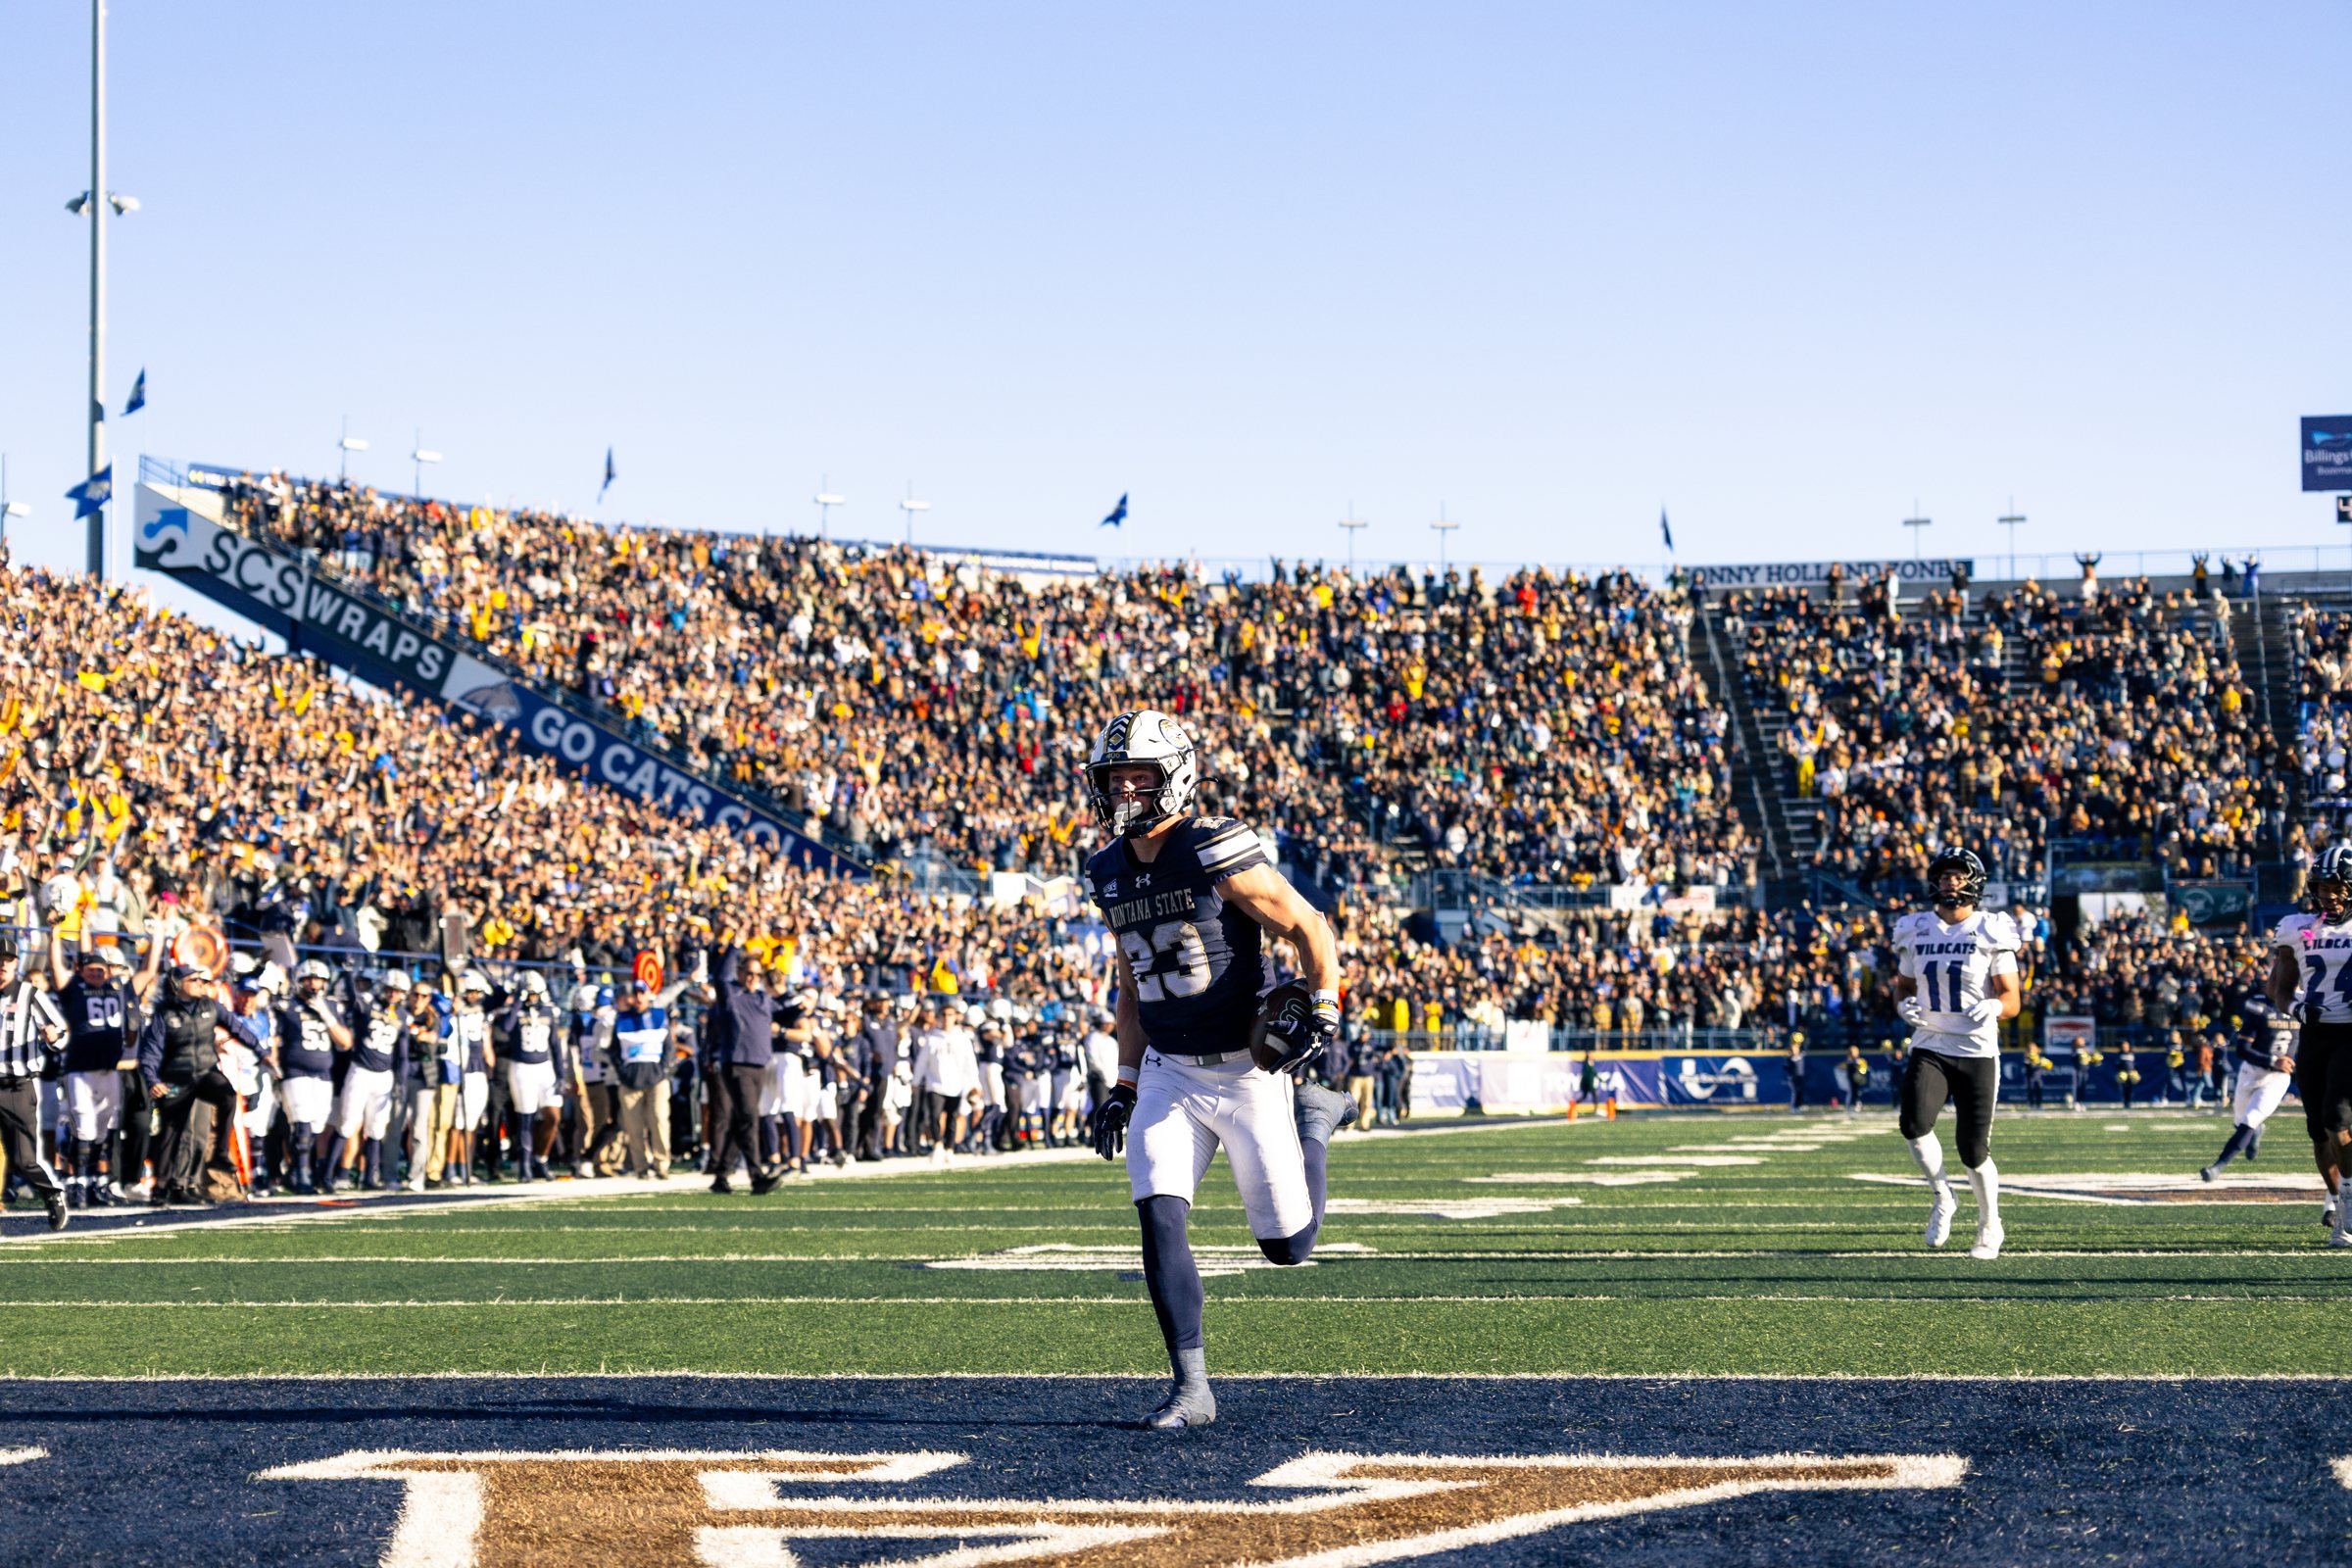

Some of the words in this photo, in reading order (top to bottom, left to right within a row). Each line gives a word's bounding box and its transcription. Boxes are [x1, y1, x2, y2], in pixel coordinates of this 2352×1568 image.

[2305, 450, 2349, 466] Billings
[1684, 565, 1760, 584] ONNY
[1768, 562, 1881, 583] HOLLND
[307, 583, 446, 680] WRAPS
[531, 708, 596, 761] GO
[601, 744, 712, 816] CATS
[1109, 897, 1152, 929] MONTANA
[1155, 887, 1196, 916] STATE
[1120, 920, 1212, 1003] 23
[1915, 943, 1977, 956] WILDCATS
[1923, 960, 1964, 1012] 11
[86, 997, 122, 1028] 60
[301, 1019, 331, 1052] 53
[1542, 1071, 1627, 1092] TOYTA
